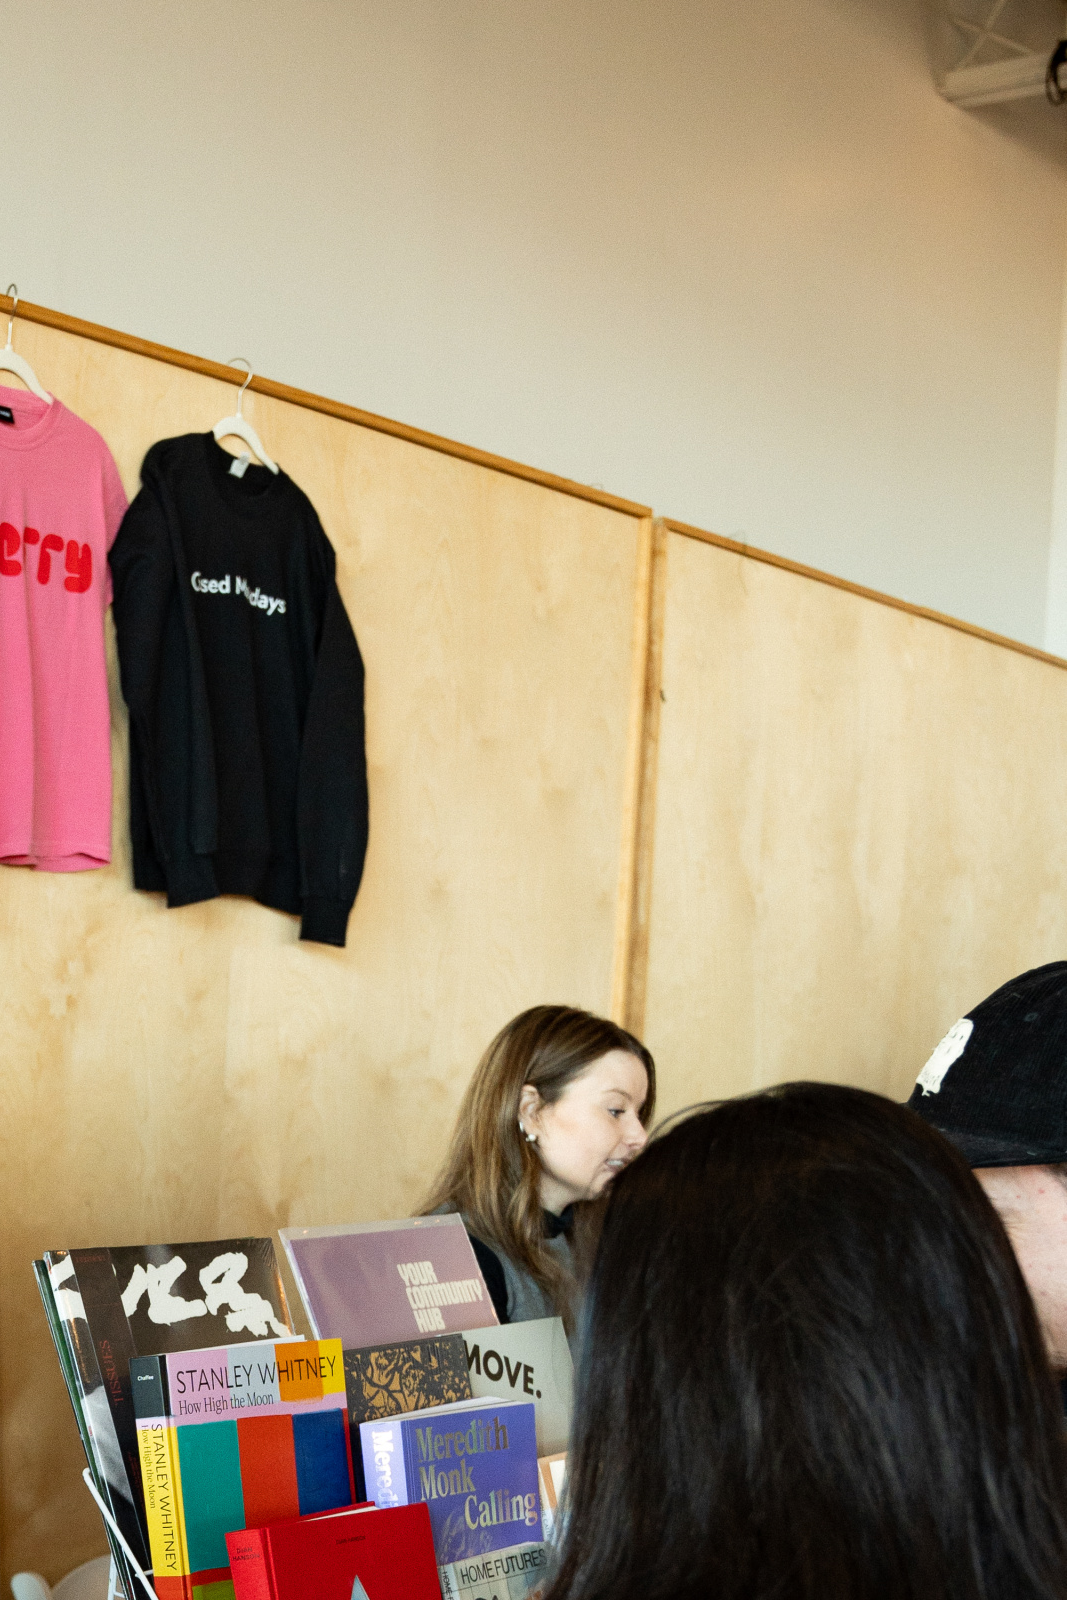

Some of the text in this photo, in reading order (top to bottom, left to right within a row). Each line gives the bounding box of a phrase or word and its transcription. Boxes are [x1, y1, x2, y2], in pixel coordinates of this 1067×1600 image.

[397, 1261, 437, 1286] YOUR
[406, 1278, 483, 1309] COMMUNITY
[413, 1307, 445, 1333] HUB
[176, 1356, 336, 1393] STANLEY WHITNEY
[178, 1392, 274, 1416] How High the Moon
[141, 1424, 150, 1445] How
[415, 1416, 509, 1463] Meredith
[143, 1447, 152, 1469] High
[371, 1430, 400, 1509] Meredi
[147, 1482, 156, 1509] Moon
[418, 1458, 476, 1501] Monk
[151, 1424, 177, 1571] STANLEY WHITNEY
[464, 1489, 538, 1530] Calling
[460, 1548, 547, 1584] HOME FUTURES
